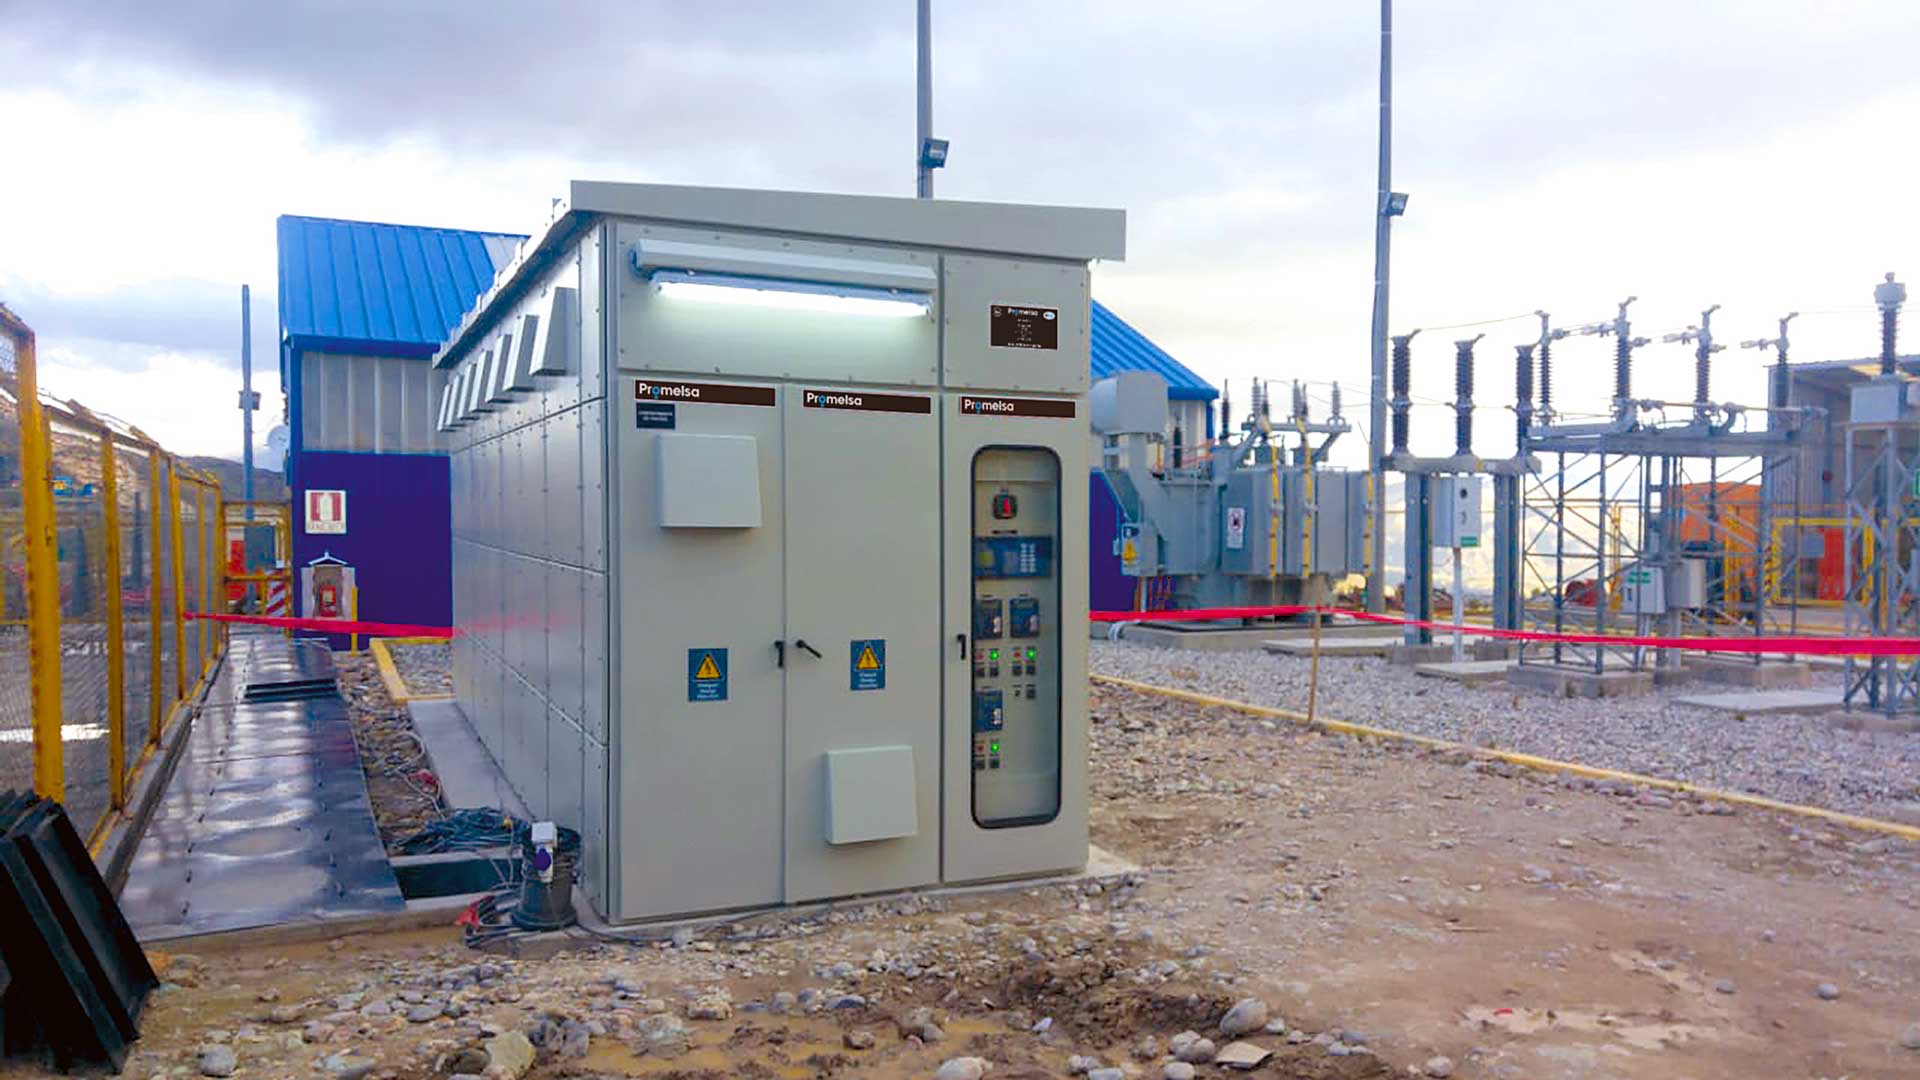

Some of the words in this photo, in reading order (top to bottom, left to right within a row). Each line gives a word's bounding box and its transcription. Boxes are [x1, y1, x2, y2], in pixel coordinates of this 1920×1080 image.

[639, 382, 700, 399] Promelsa
[806, 391, 862, 407] Promelsa
[964, 398, 1015, 412] Promelsa
